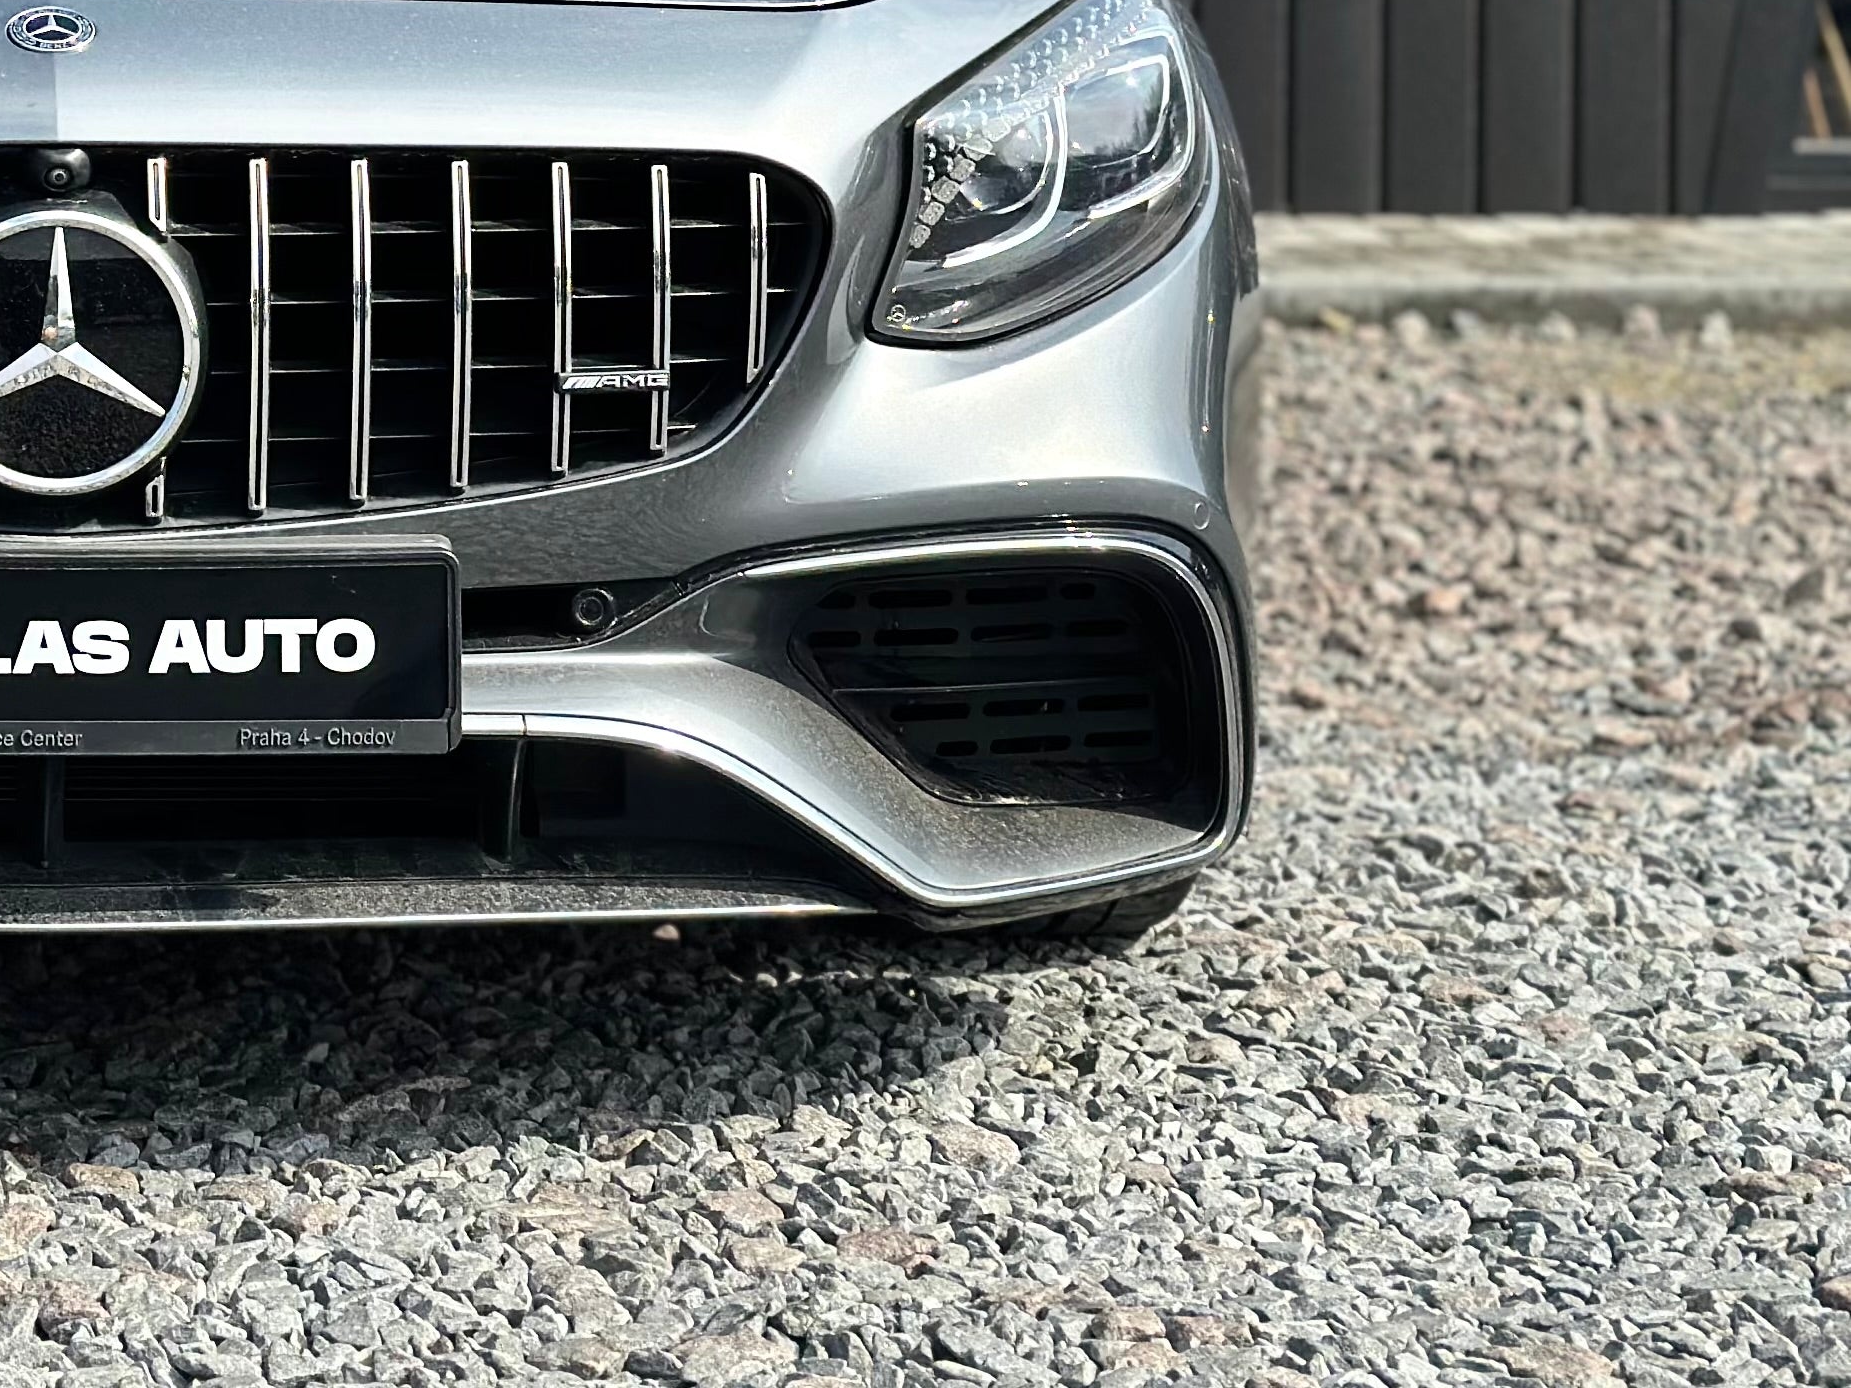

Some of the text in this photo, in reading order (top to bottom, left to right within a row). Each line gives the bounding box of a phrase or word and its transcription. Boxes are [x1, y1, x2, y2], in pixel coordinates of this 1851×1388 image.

[148, 618, 377, 675] AUTO
[20, 728, 84, 748] Center
[239, 727, 292, 747] Praha
[297, 727, 310, 746] 4
[326, 726, 397, 748] Chodov
